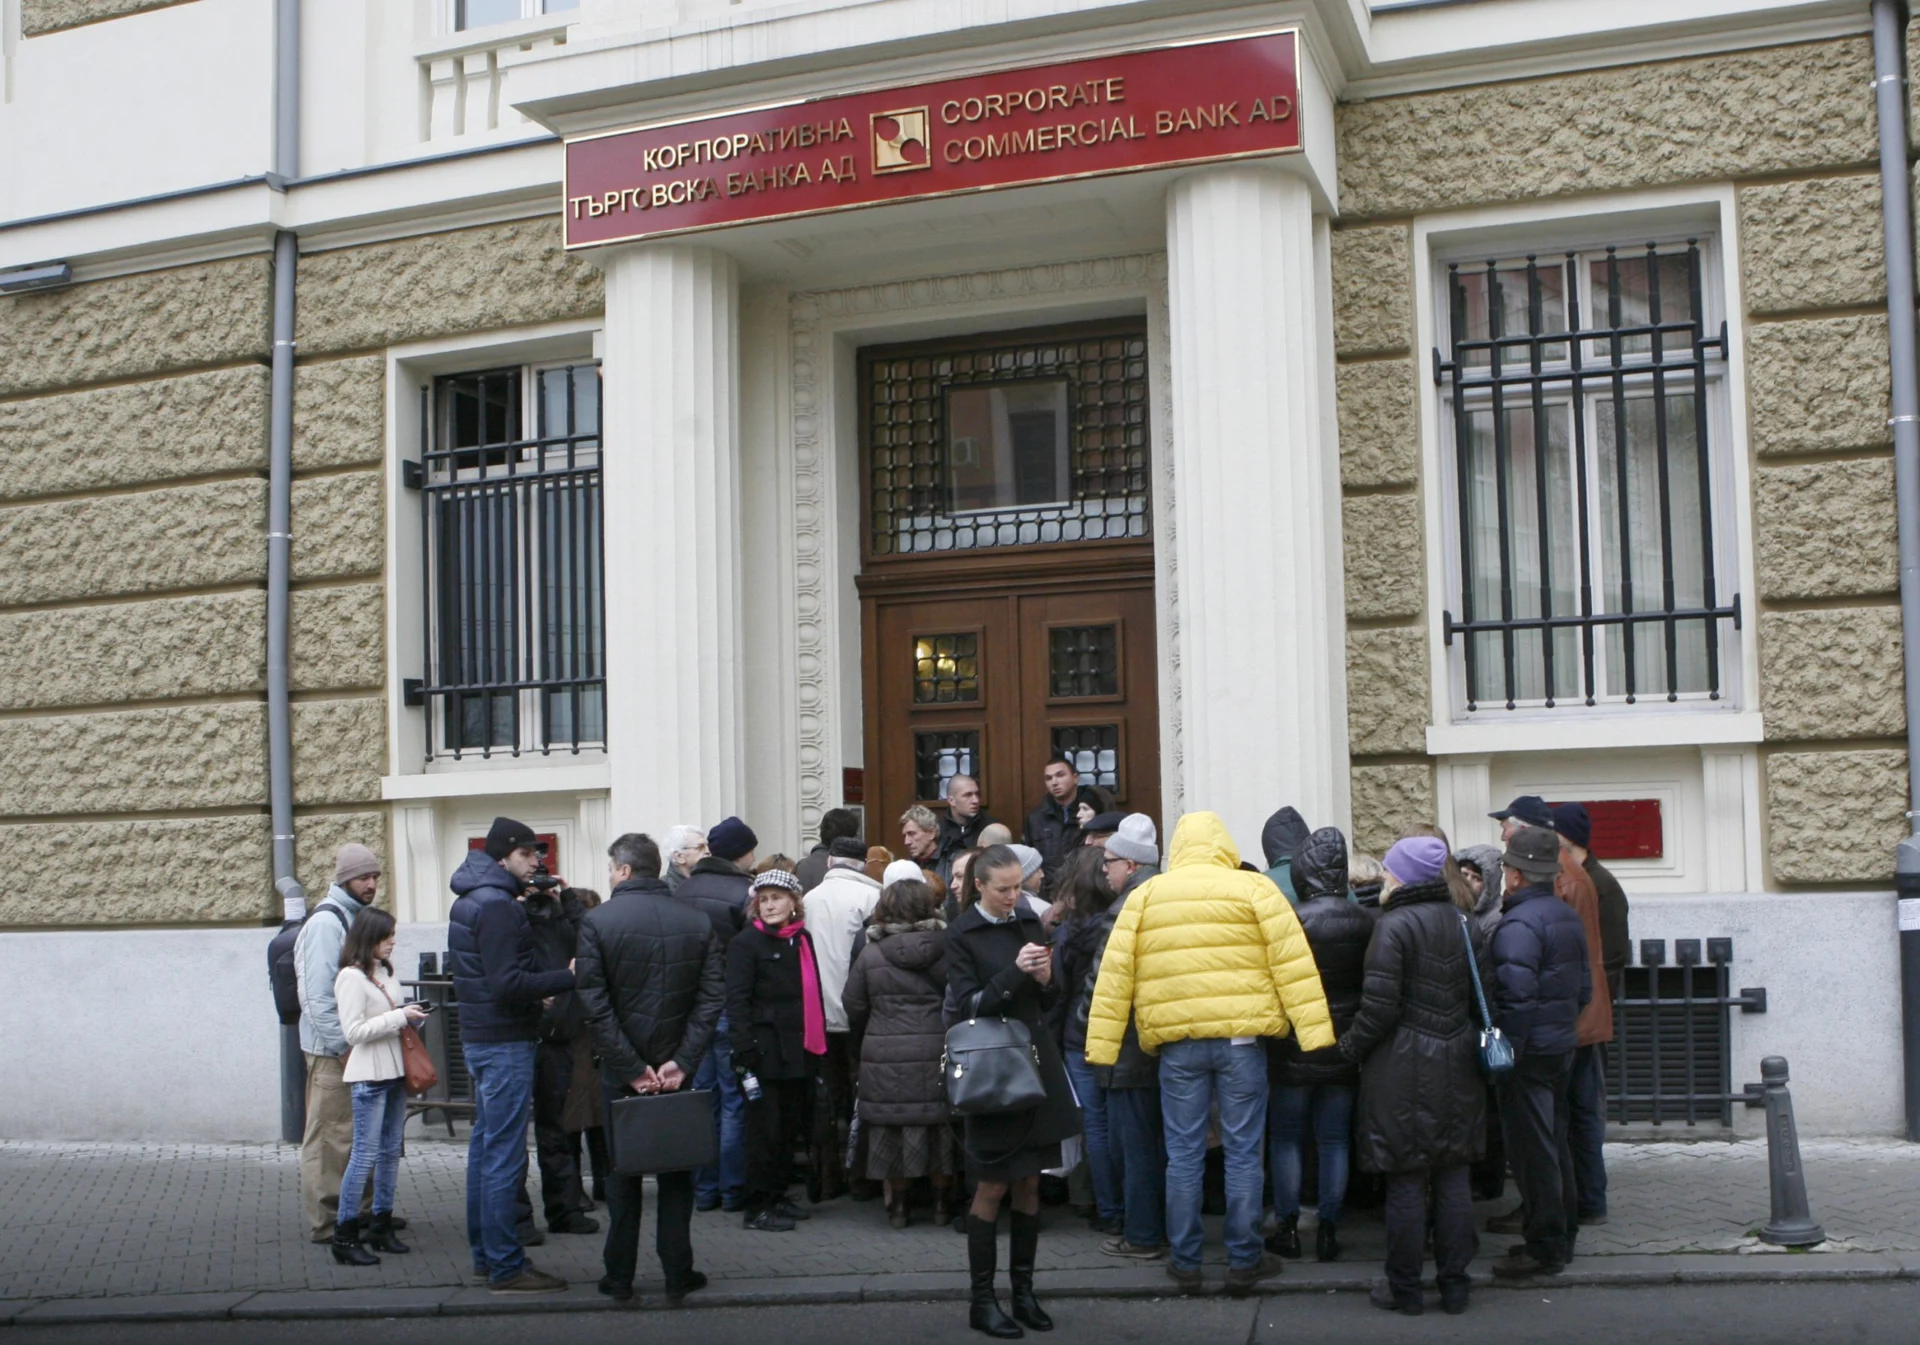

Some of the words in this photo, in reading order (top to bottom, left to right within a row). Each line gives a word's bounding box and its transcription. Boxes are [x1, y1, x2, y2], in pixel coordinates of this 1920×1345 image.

[942, 78, 1124, 124] CORPORATE
[943, 116, 1145, 163] COMMERCIAL
[1156, 101, 1239, 135] BANK
[1249, 96, 1291, 122] AD
[644, 118, 854, 171] КОРПОРАТИВНА
[570, 178, 719, 219] ТЪРГОВСКА
[727, 164, 811, 197] БАНКА
[819, 156, 856, 183] АД
